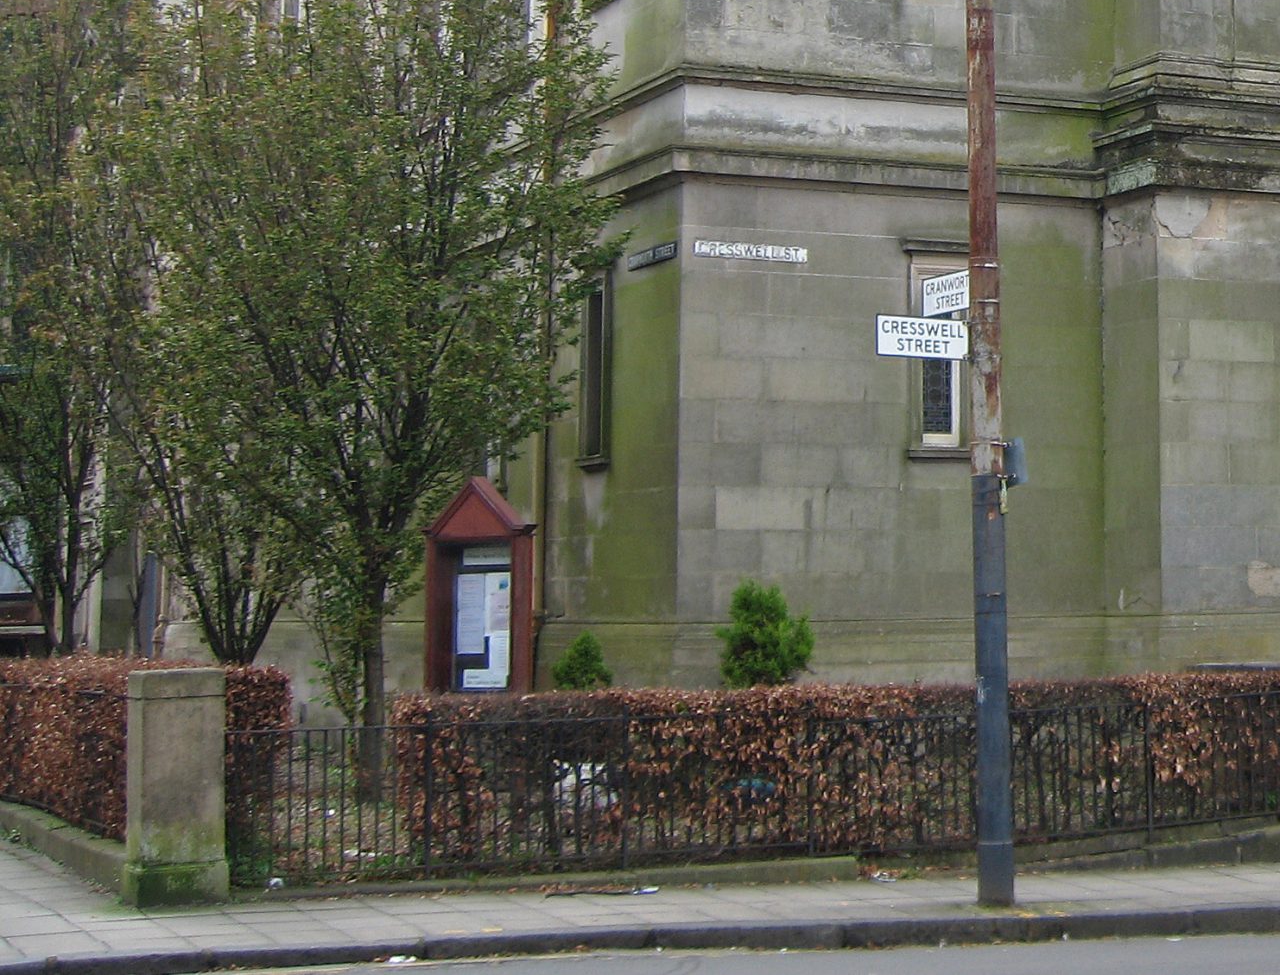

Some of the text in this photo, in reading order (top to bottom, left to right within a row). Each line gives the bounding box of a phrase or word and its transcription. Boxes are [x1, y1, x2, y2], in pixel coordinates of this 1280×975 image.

[926, 274, 969, 296] CRANWORT
[936, 292, 964, 309] STREET
[882, 320, 964, 338] CRESSWELL
[897, 338, 951, 354] STREET
